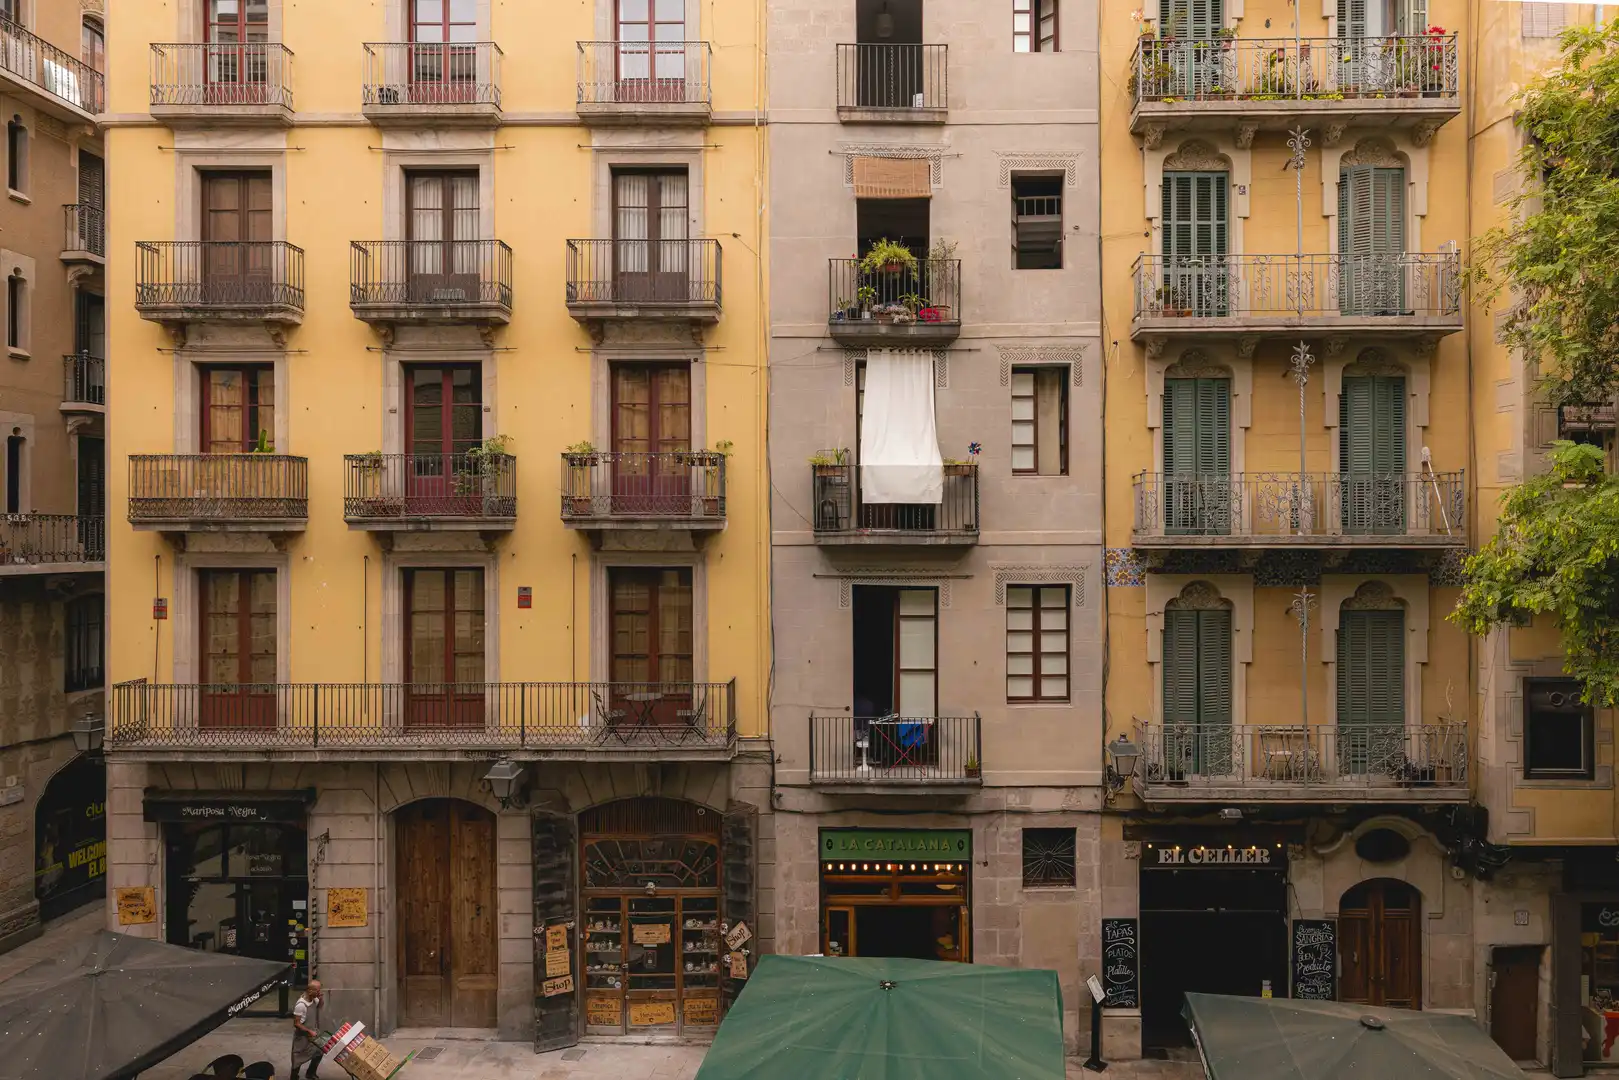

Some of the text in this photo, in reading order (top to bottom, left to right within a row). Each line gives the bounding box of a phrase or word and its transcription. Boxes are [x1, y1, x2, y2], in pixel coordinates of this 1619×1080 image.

[182, 805, 257, 818] Mariposa Negra
[840, 838, 952, 852] LA CATALANA
[1158, 848, 1271, 864] EL CELLER
[727, 927, 746, 947] Shop
[1106, 926, 1134, 940] TAPAS
[1108, 947, 1133, 958] PLATOS
[1297, 958, 1332, 974] Producto
[545, 978, 571, 993] Shop
[228, 992, 260, 1016] Mariposa
